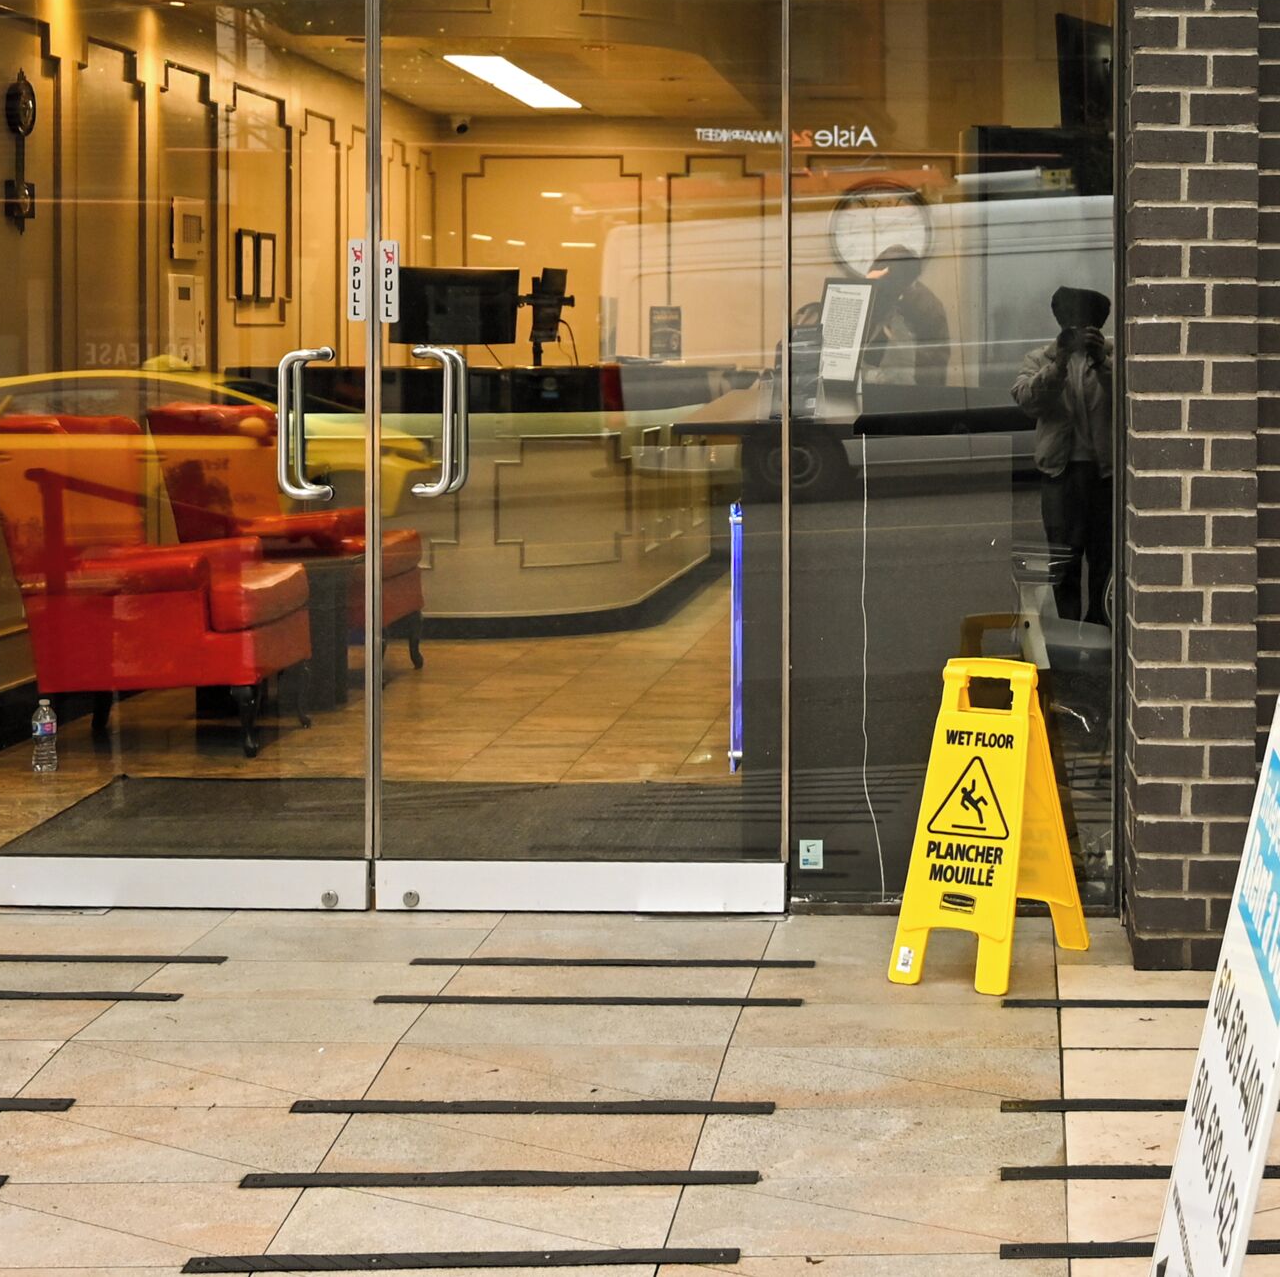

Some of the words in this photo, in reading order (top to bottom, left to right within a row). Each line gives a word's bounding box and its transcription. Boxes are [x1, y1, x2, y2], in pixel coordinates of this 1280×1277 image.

[352, 266, 361, 316] PULL
[384, 267, 393, 317] PULL
[945, 728, 974, 747] WET
[974, 731, 1015, 750] FLOOR
[926, 840, 1004, 865] PLANCHER
[928, 863, 995, 888] MOUILLÉ
[1213, 958, 1236, 1044] 604
[1225, 997, 1248, 1087] 689
[1239, 1043, 1264, 1153] 4400
[1191, 1057, 1213, 1146] 604
[1202, 1102, 1223, 1195] 689
[1213, 1154, 1239, 1268] 1423
